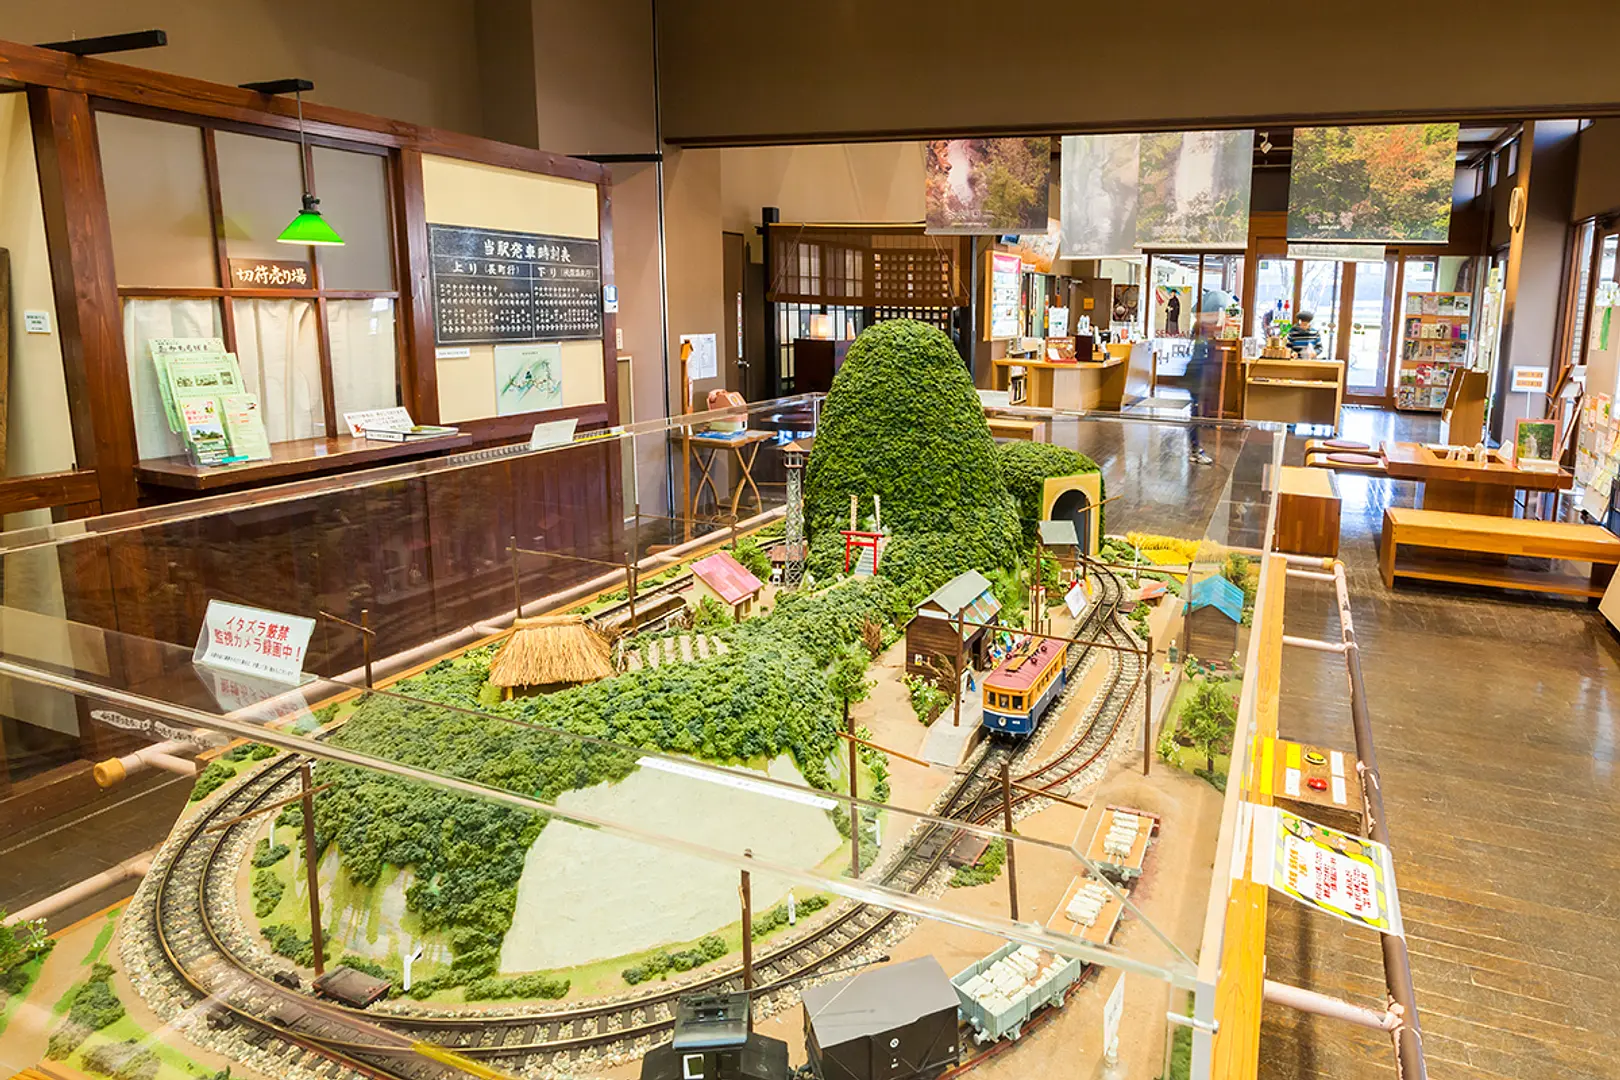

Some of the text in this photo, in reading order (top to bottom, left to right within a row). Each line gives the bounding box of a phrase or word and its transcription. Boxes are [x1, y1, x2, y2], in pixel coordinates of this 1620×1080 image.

[484, 238, 571, 263] 当駅発車時刻表
[236, 264, 307, 285] 切符売り場
[226, 616, 291, 642] イタズラ厳禁
